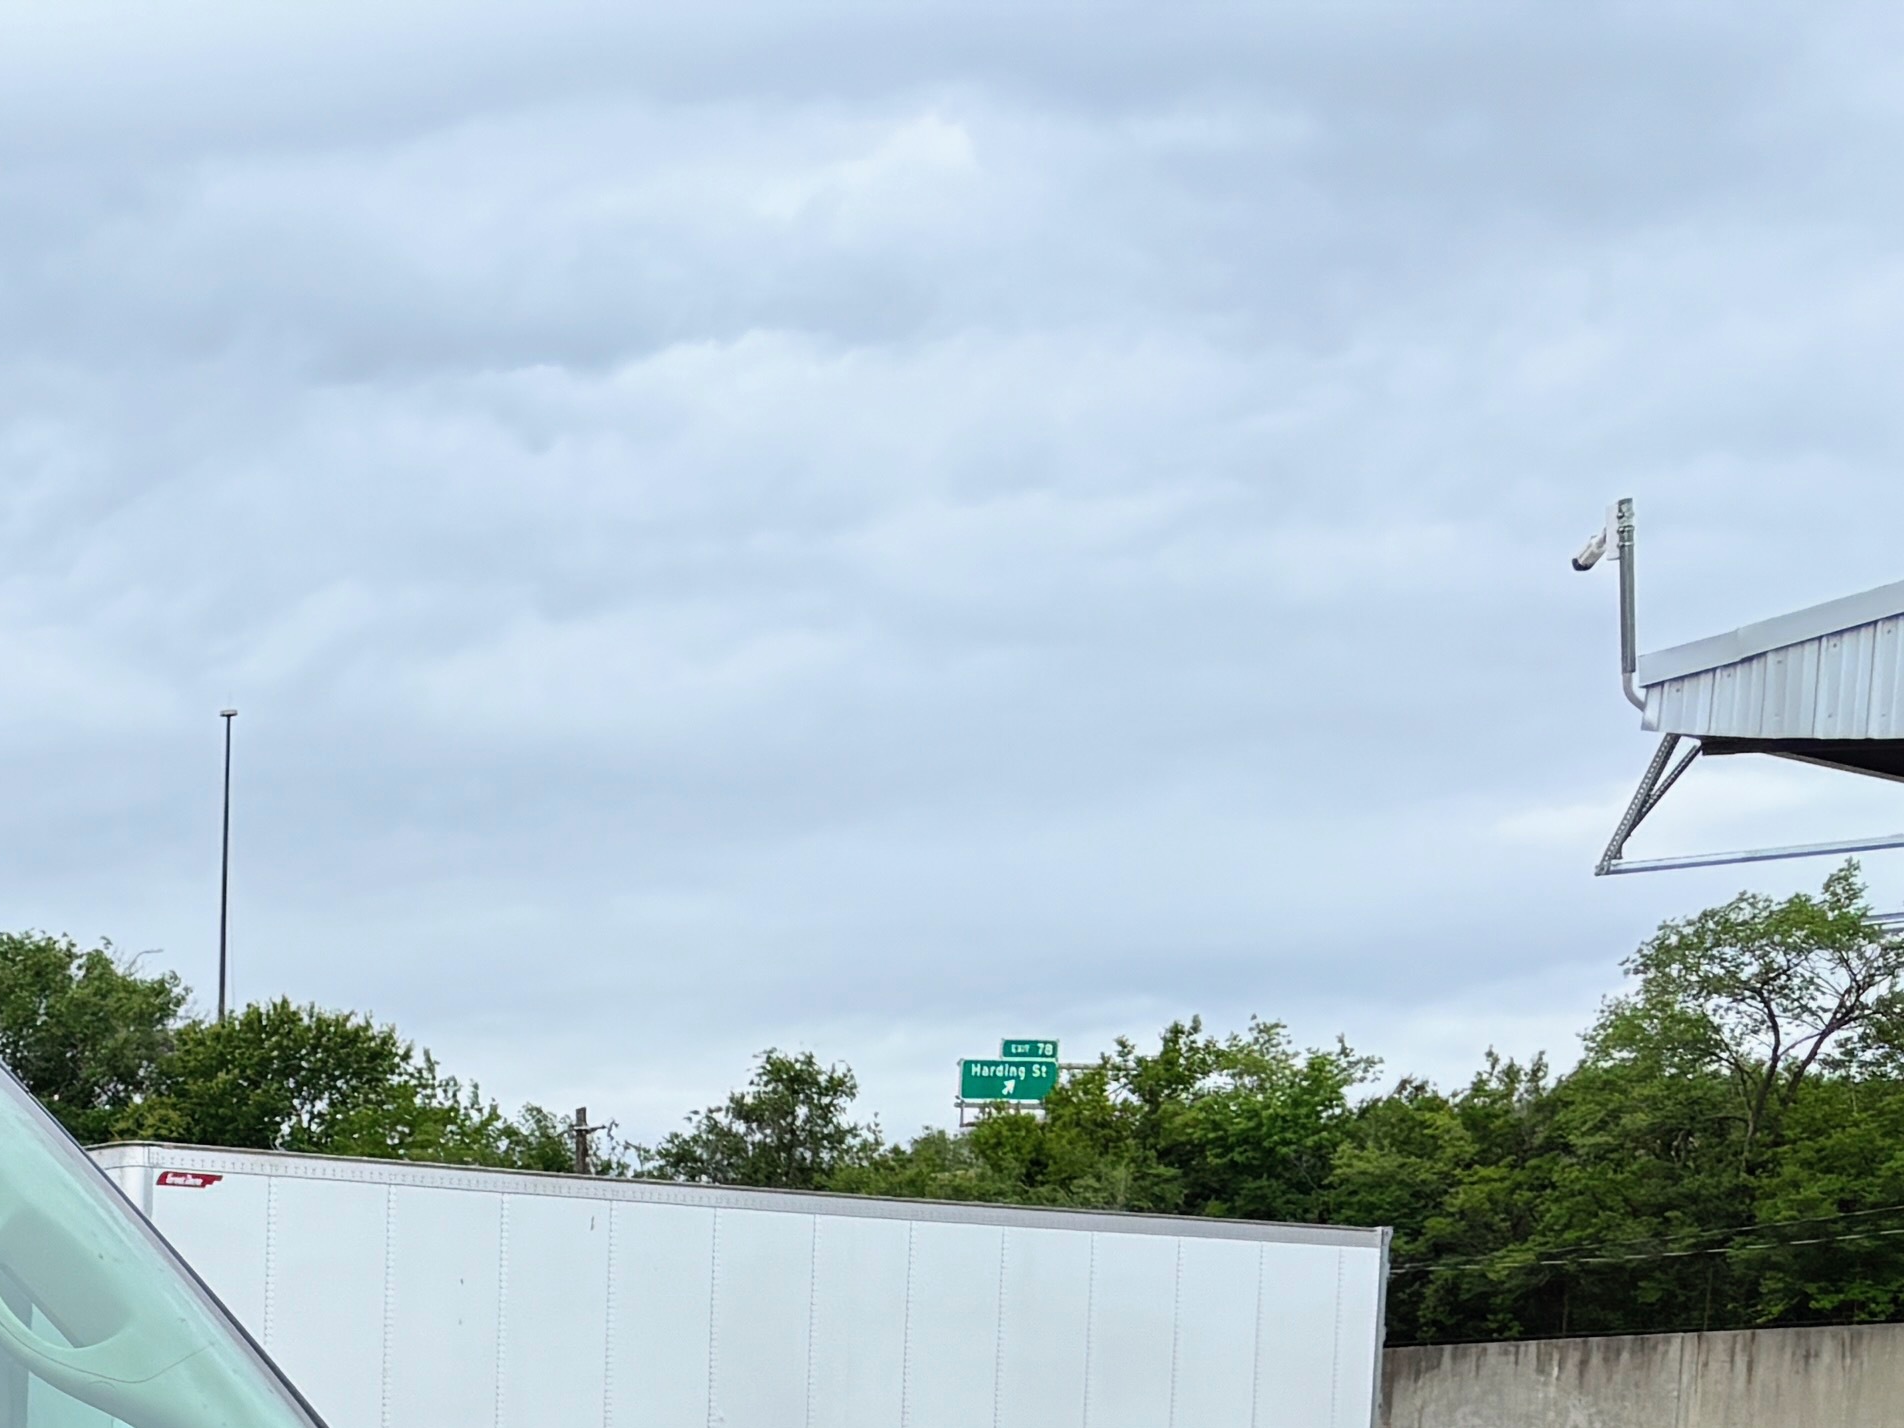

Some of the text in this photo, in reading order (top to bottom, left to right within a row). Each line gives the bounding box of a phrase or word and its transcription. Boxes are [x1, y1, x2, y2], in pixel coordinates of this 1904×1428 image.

[1010, 1043, 1054, 1056] EXIT 78
[971, 1063, 1047, 1081] Harding St
